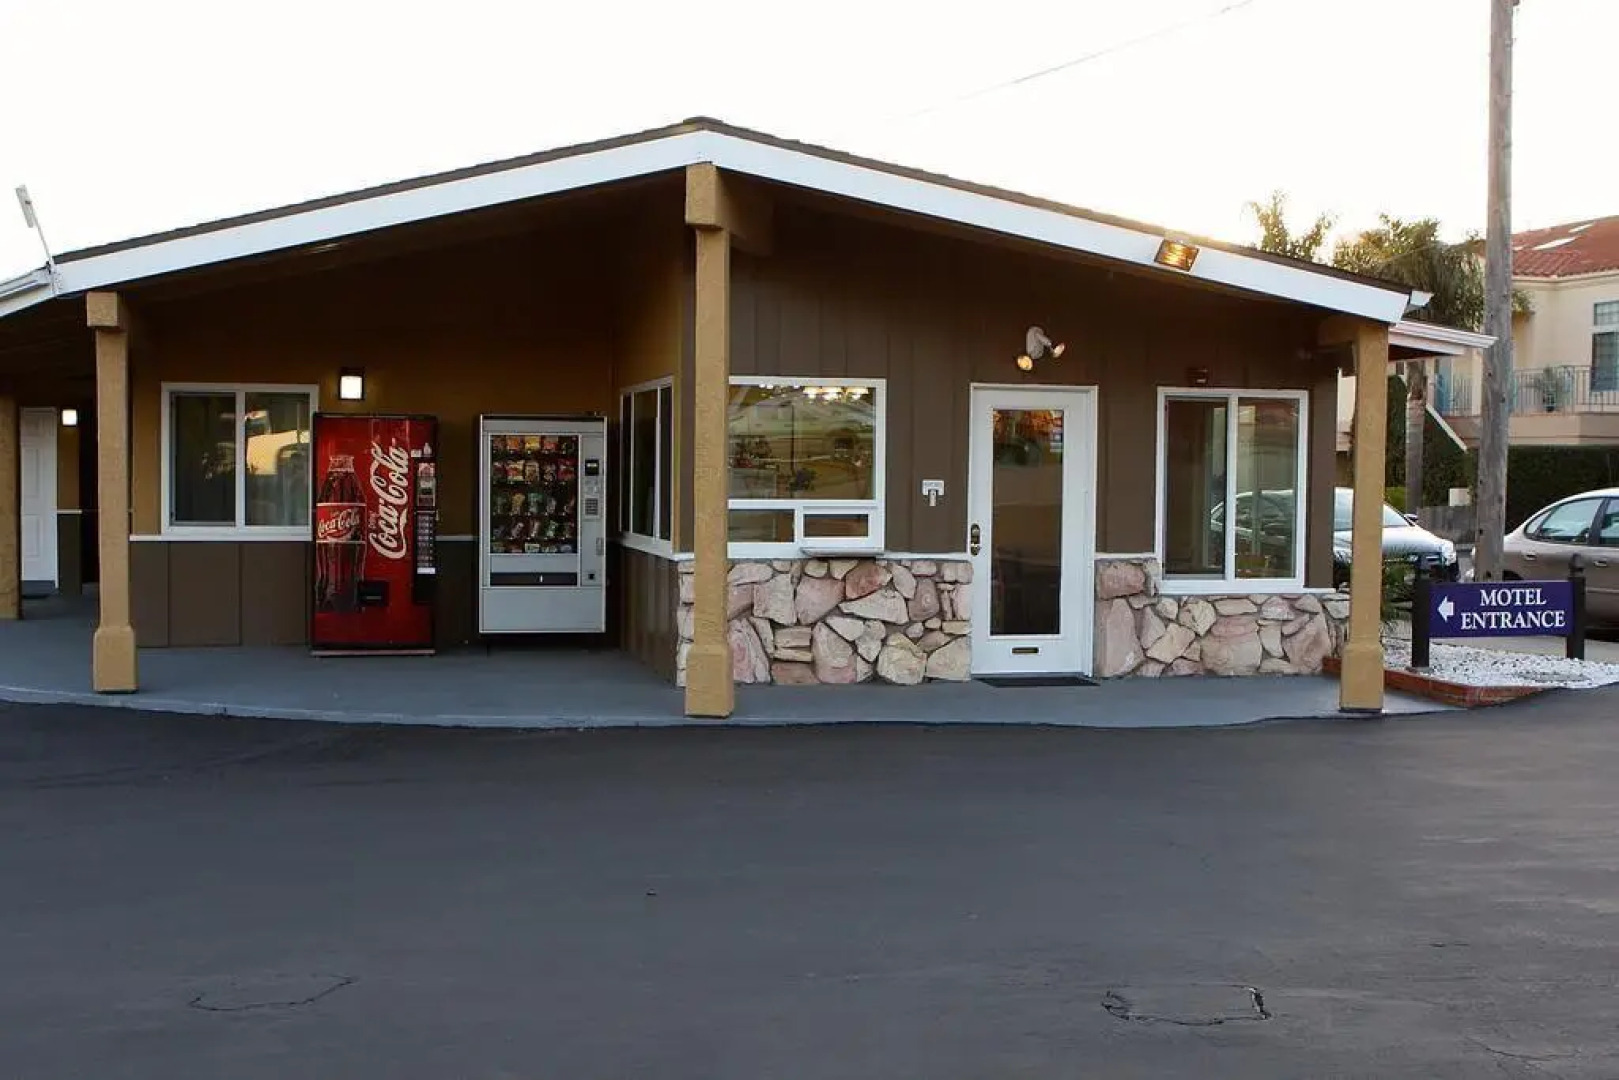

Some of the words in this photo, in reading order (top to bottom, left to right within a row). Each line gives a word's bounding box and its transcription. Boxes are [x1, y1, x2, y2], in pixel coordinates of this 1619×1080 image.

[369, 440, 409, 559] Coca-Cola
[1480, 588, 1546, 606] MOTEL
[1461, 610, 1565, 630] ENTRANCE
